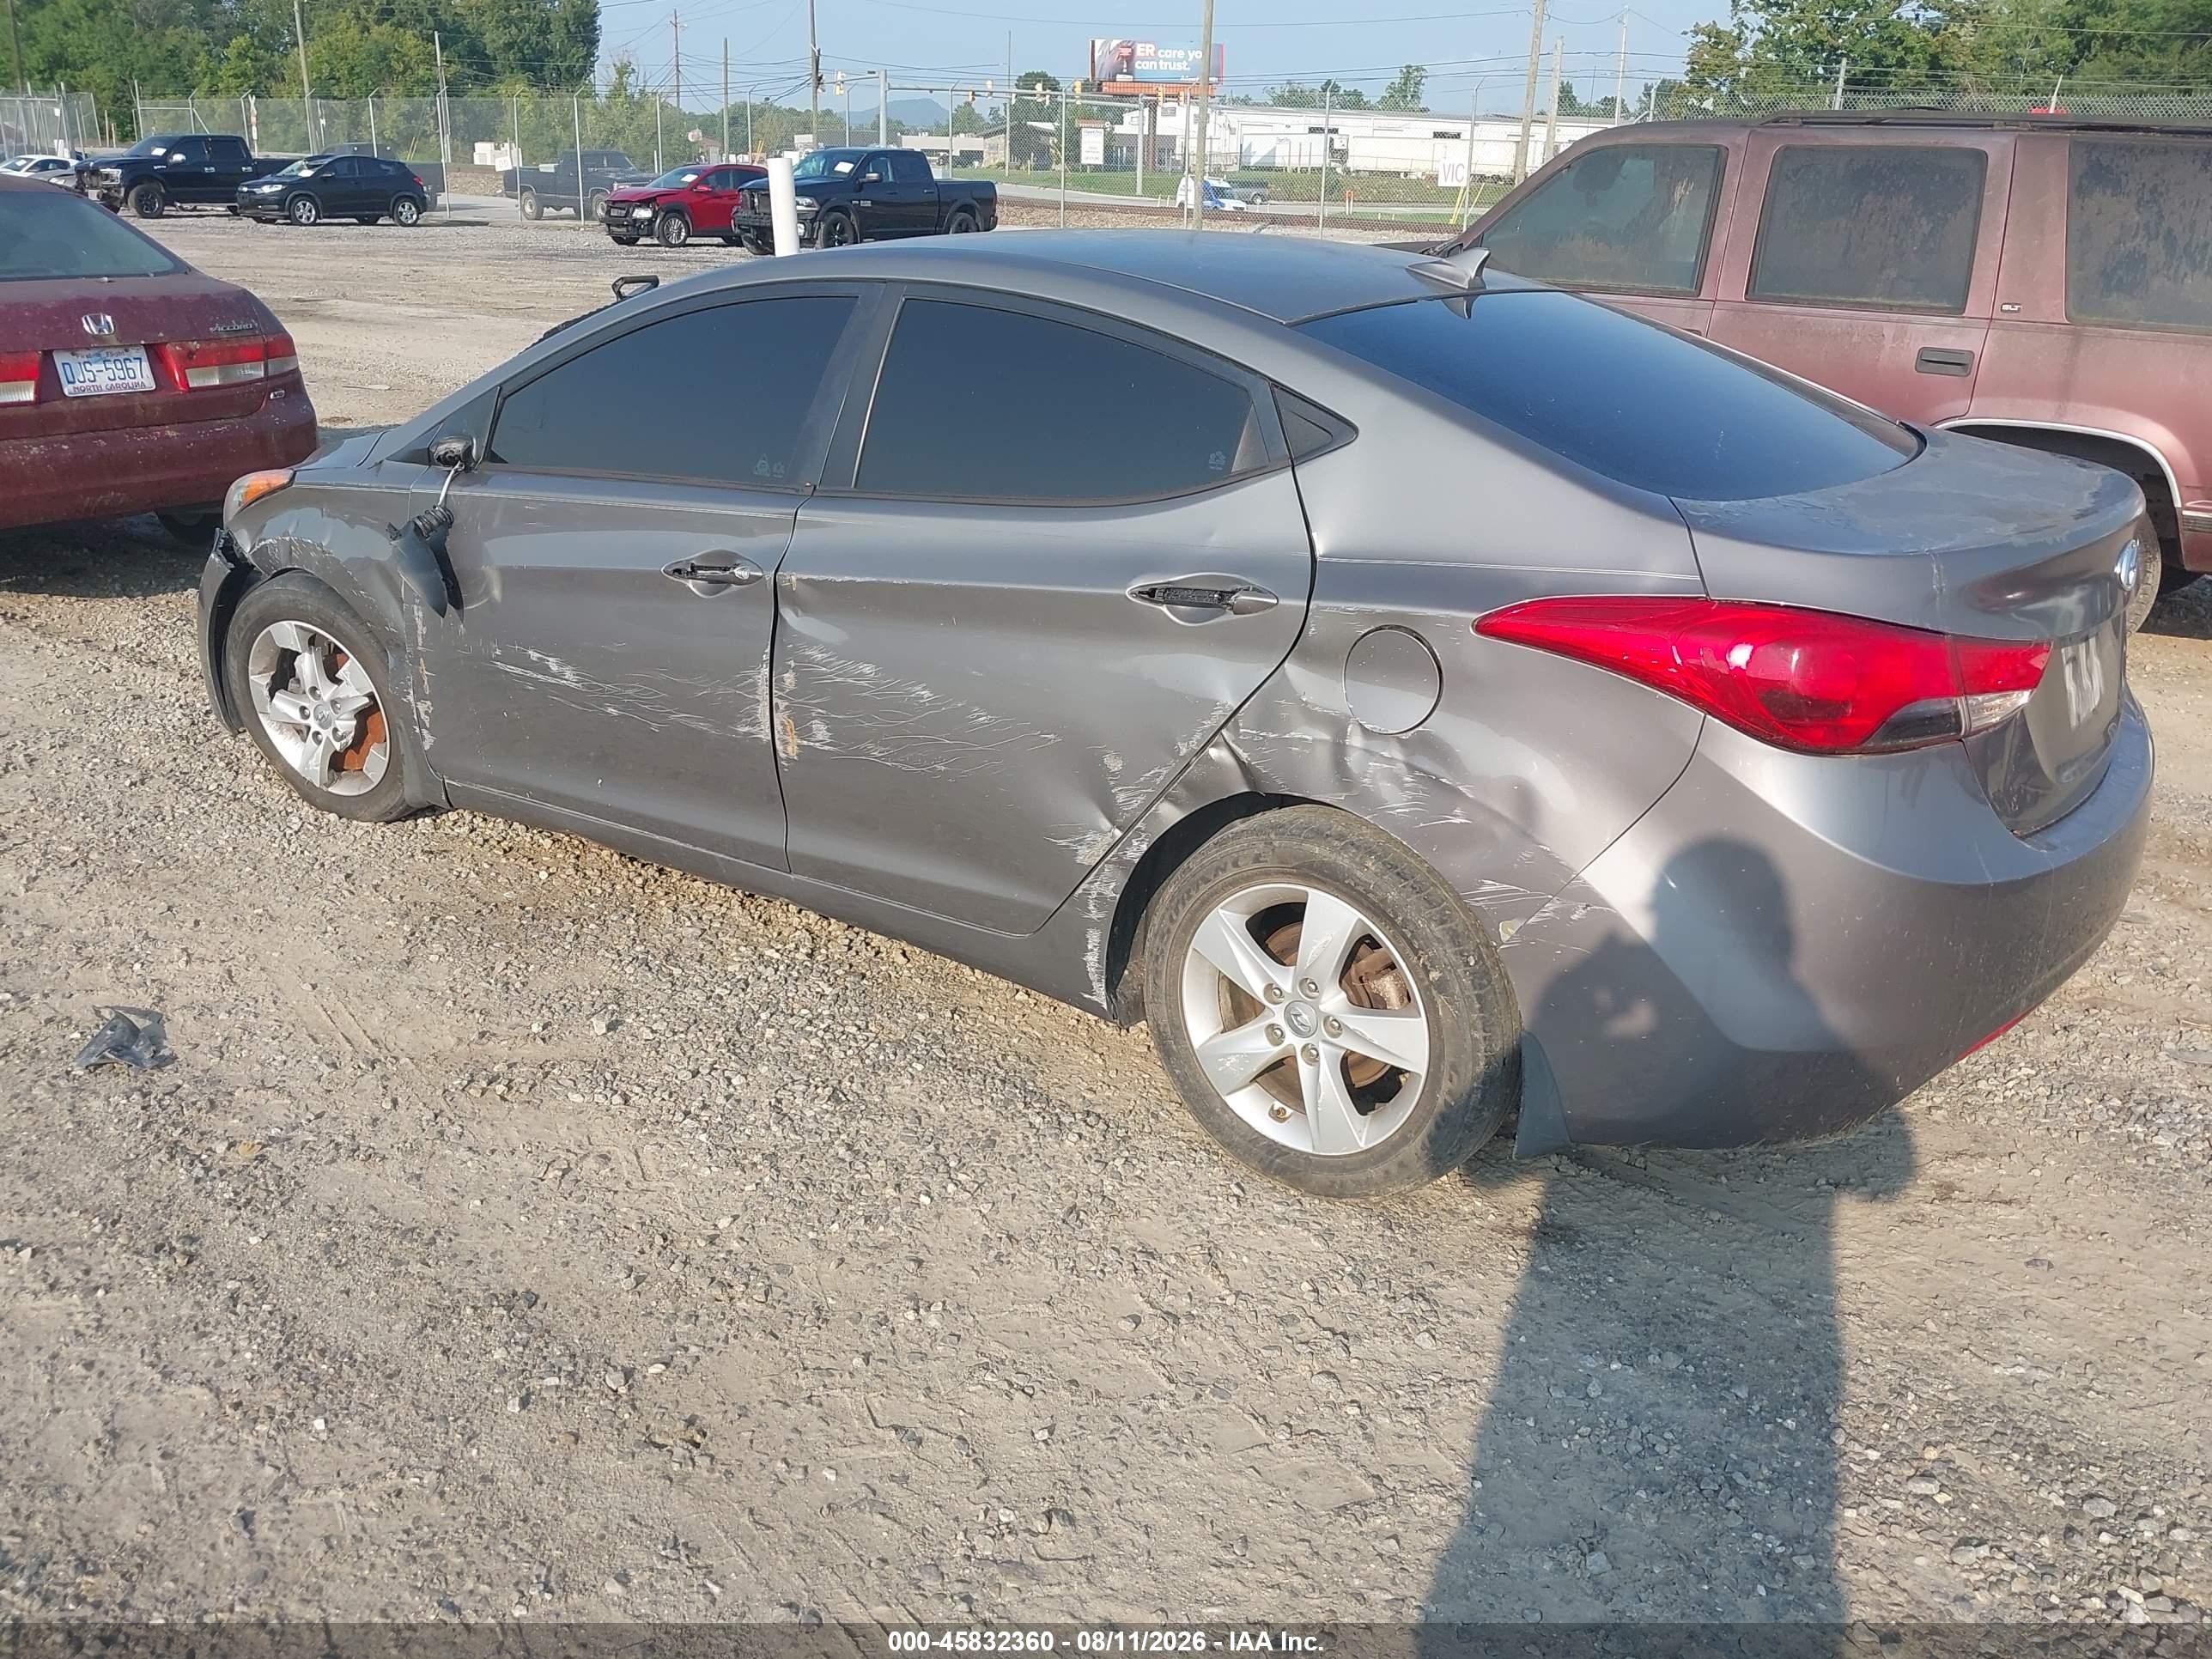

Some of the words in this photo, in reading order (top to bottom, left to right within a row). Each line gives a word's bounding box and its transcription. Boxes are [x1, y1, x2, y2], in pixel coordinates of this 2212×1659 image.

[1136, 44, 1156, 57] ER
[1158, 48, 1185, 59] care
[1187, 49, 1203, 62] yo
[1134, 60, 1157, 70] can
[1158, 59, 1190, 70] trust.
[1443, 163, 1465, 183] VIC
[61, 356, 144, 385] DJS-5967
[72, 384, 103, 392] NORTH
[105, 380, 146, 392] CAROLINA
